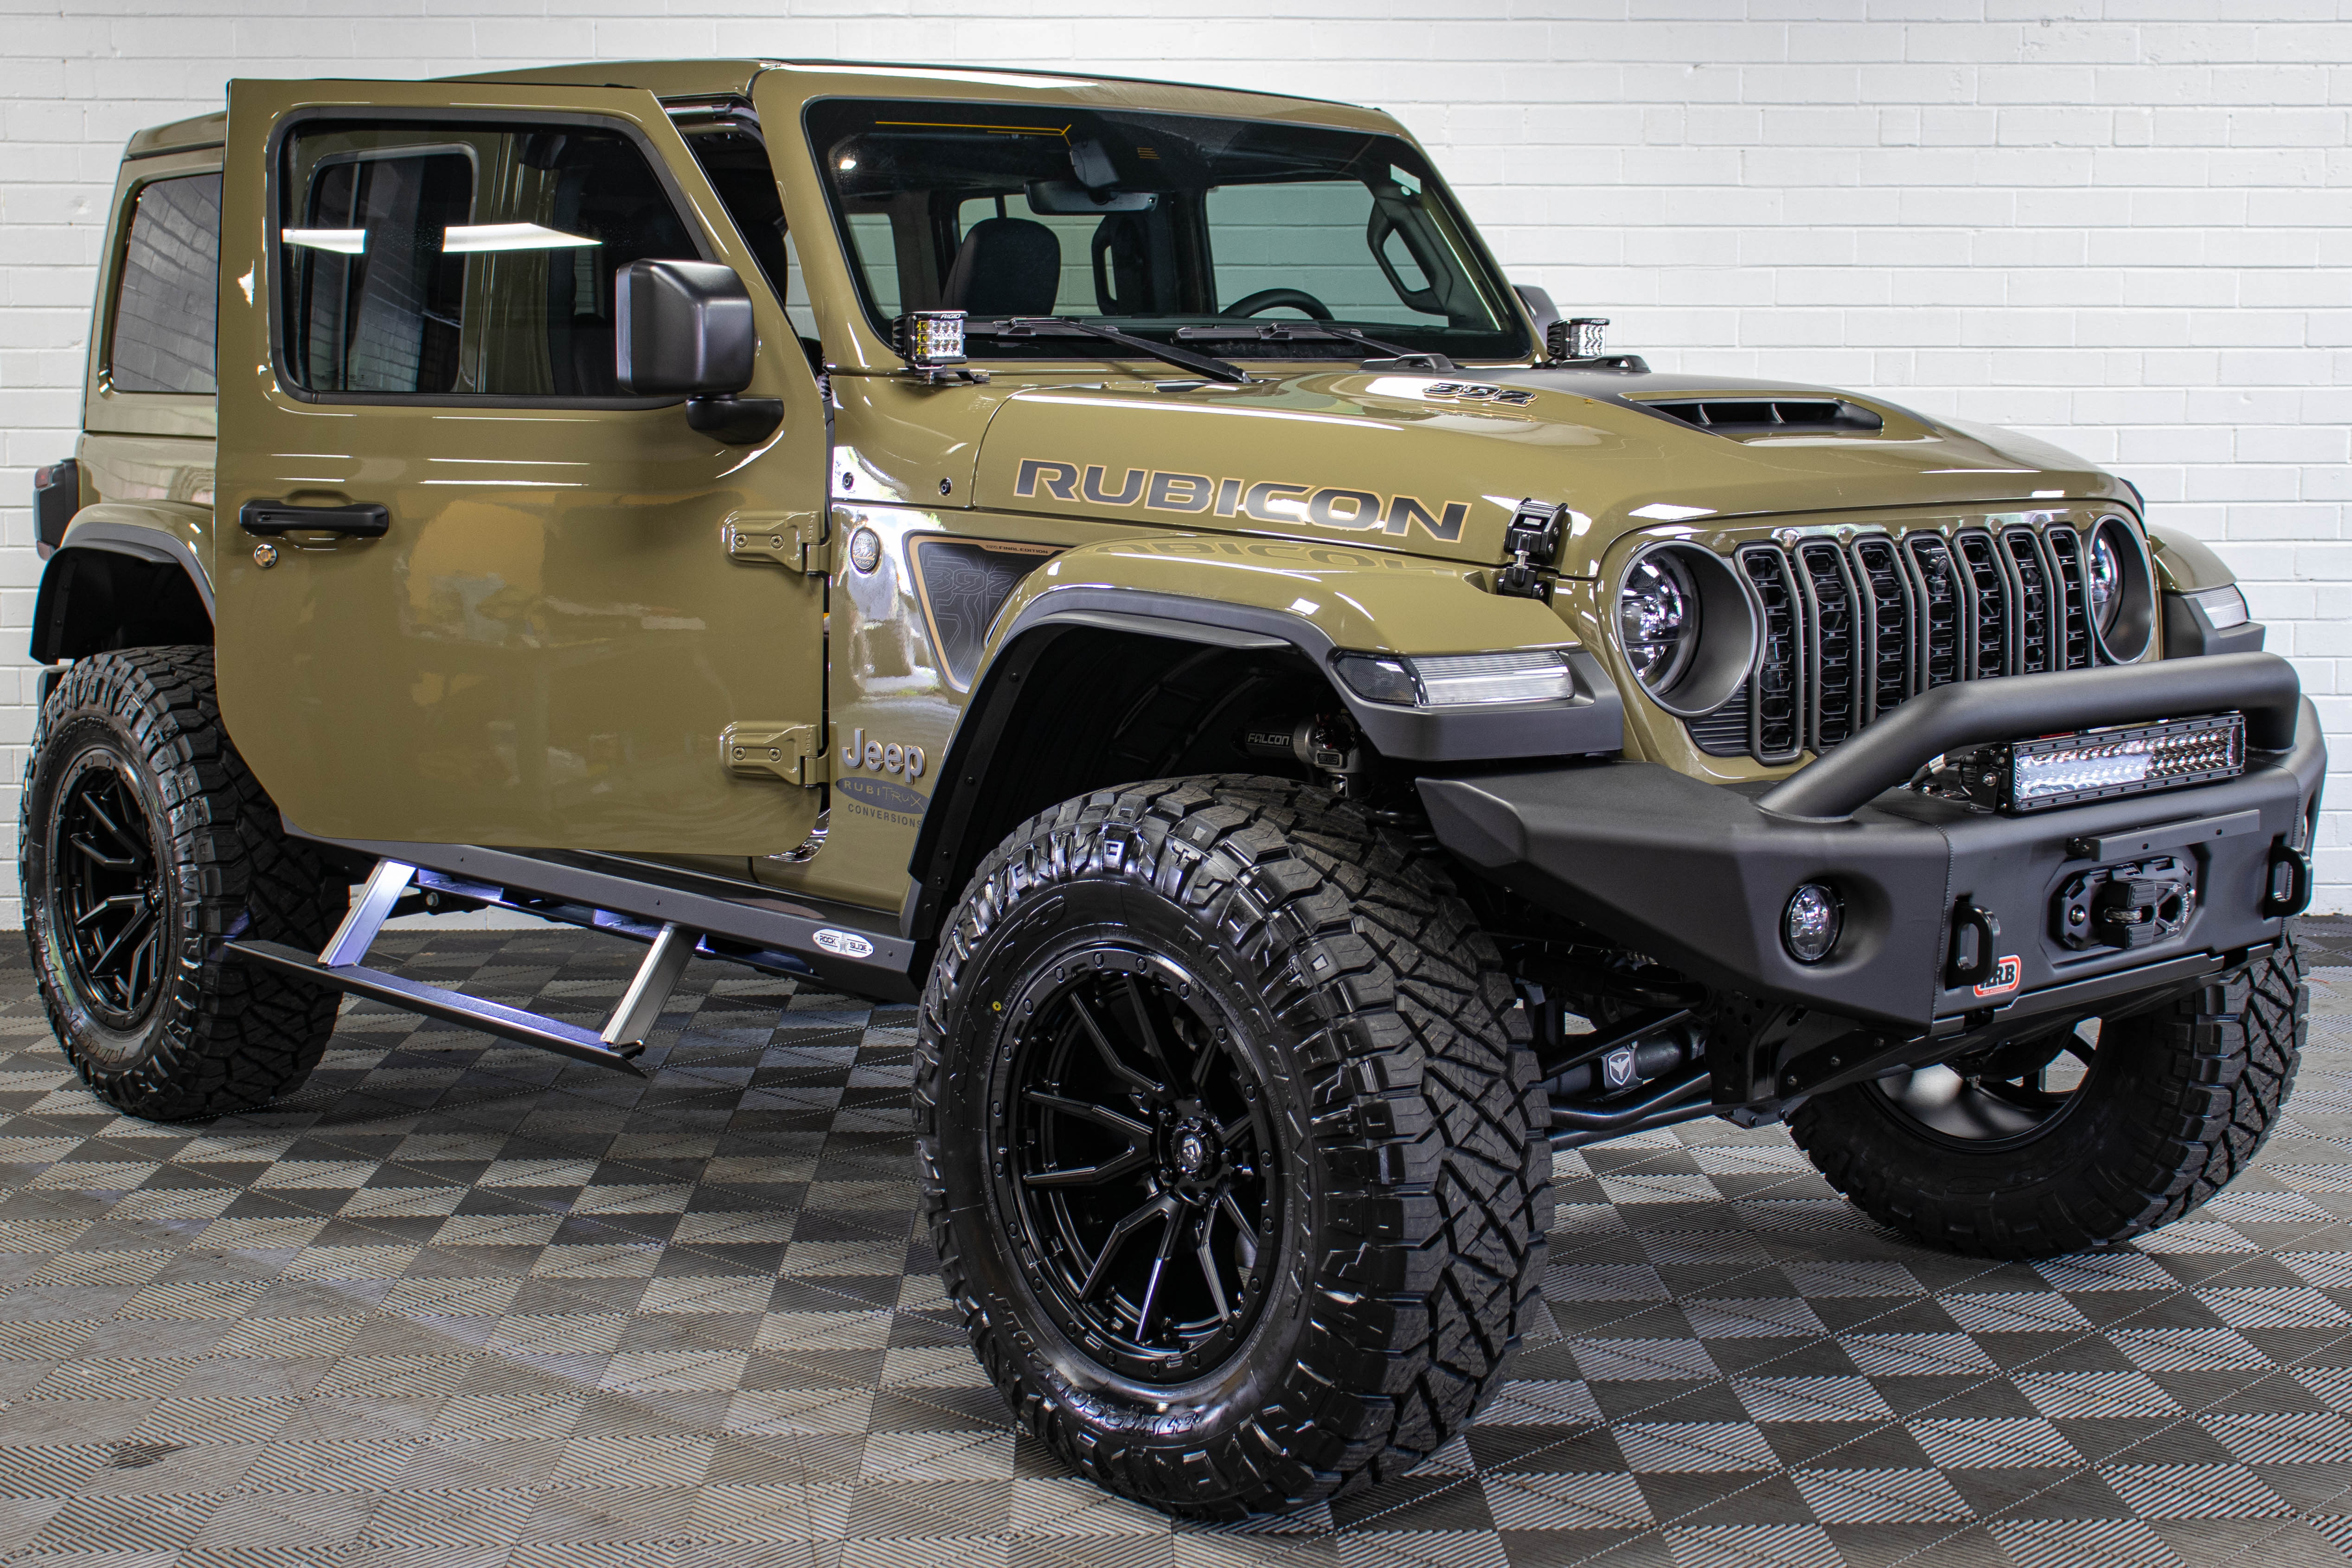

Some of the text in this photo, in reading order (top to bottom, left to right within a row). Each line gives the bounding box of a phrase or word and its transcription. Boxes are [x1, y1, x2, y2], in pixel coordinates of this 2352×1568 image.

[1423, 383, 1538, 408] 392
[1014, 458, 1472, 544] RUBICON
[1248, 733, 1289, 746] FALCON
[842, 728, 925, 785] Jeep
[848, 803, 921, 829] CONVERSIONS
[820, 935, 867, 951] ROCK SLIDE
[1178, 924, 1270, 1037] RIDGE
